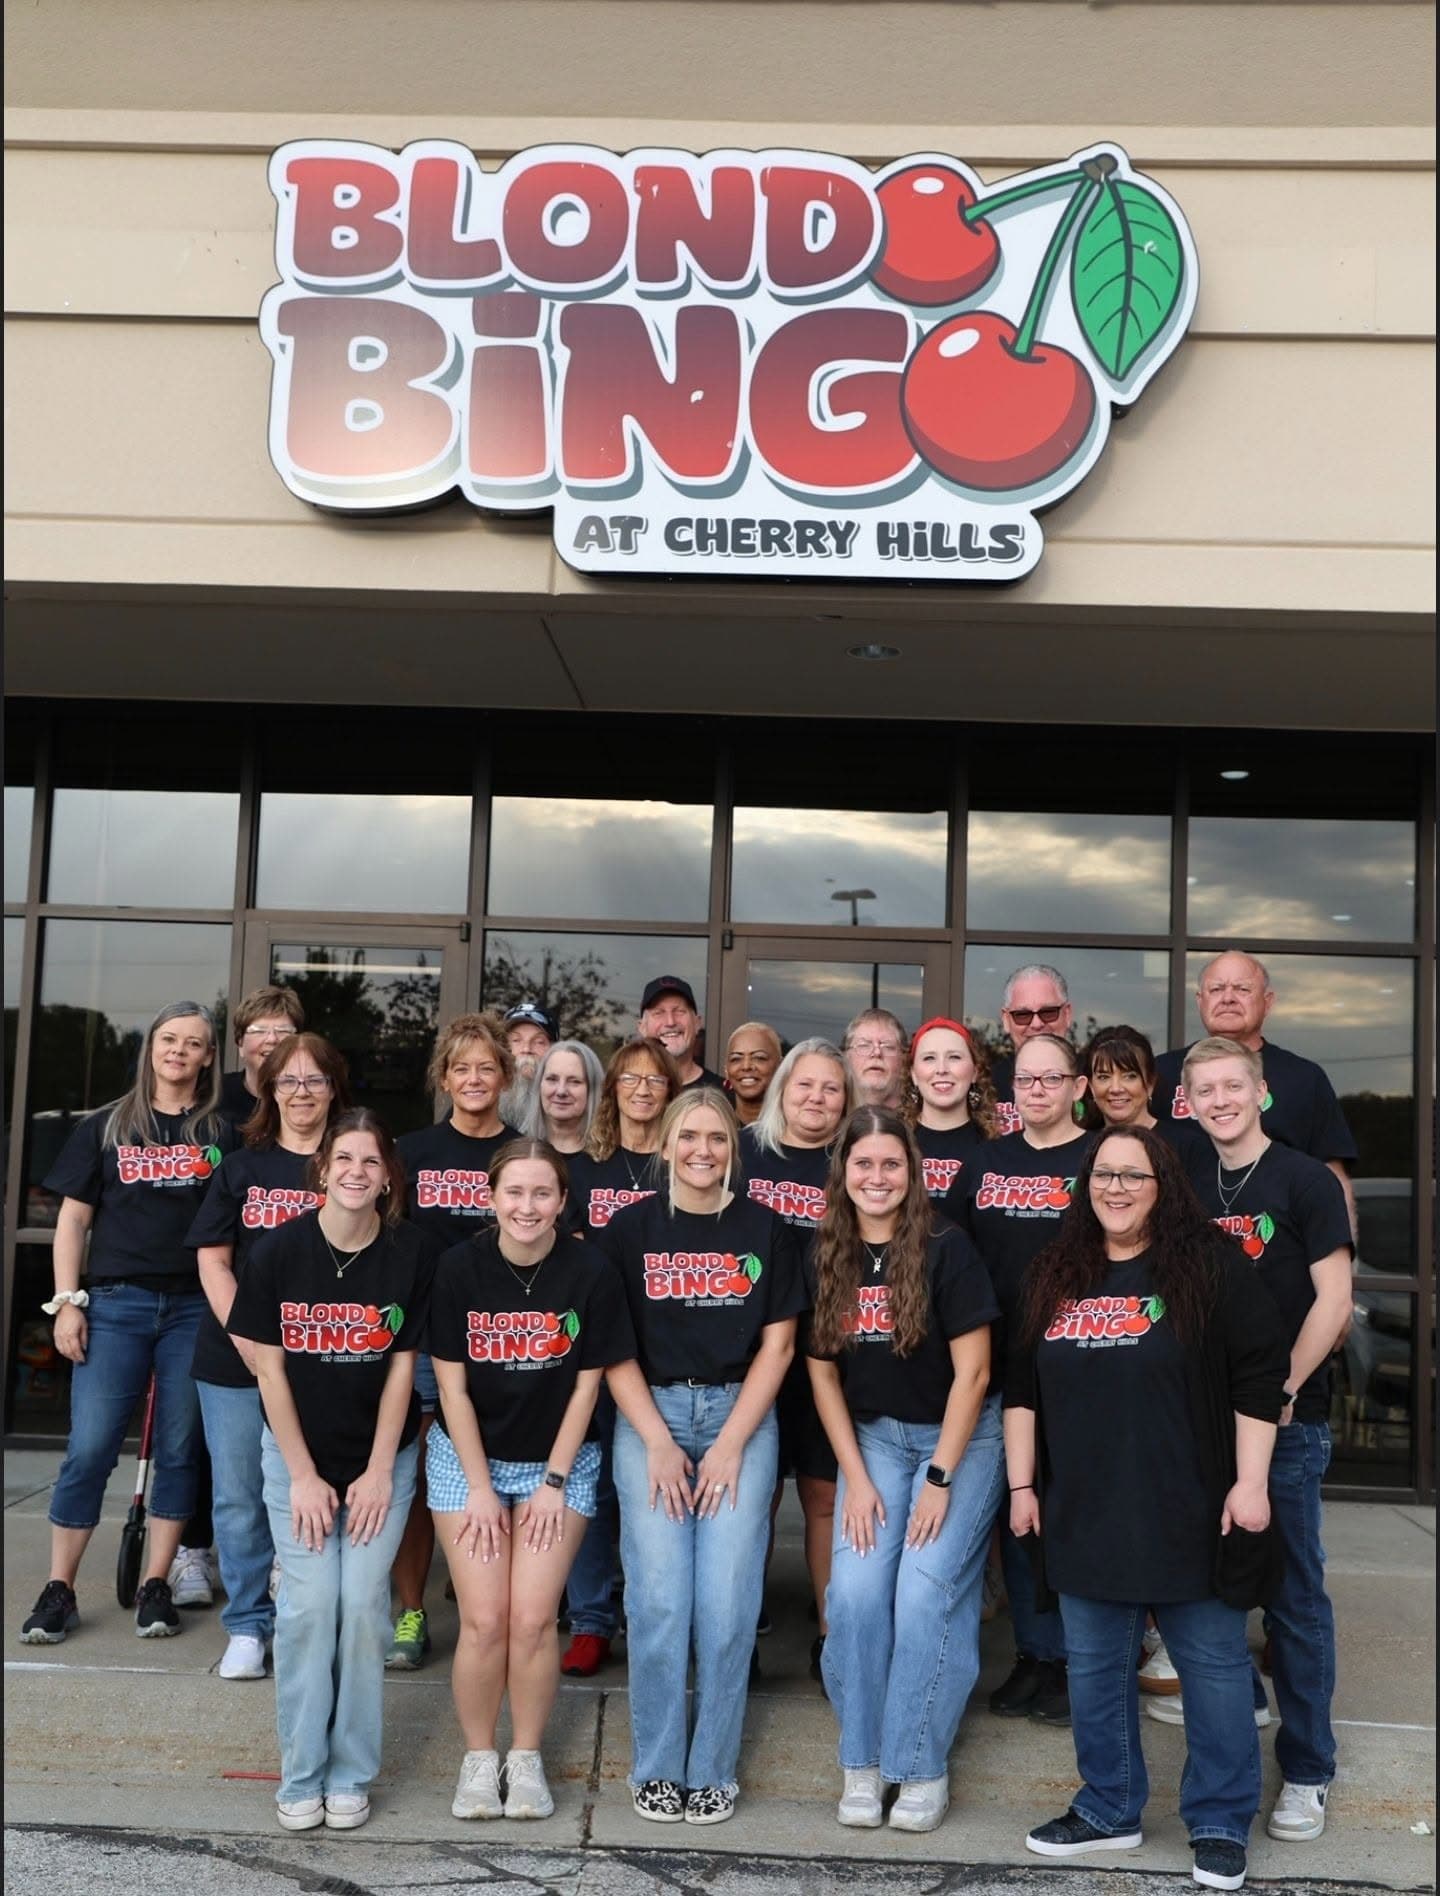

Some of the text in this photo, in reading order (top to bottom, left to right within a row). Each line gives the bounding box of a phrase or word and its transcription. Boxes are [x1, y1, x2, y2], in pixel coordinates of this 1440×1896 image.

[573, 514, 646, 553] AT
[663, 516, 859, 559] CHERRY
[417, 1169, 489, 1186] BLOND
[748, 1179, 826, 1201] BLOND
